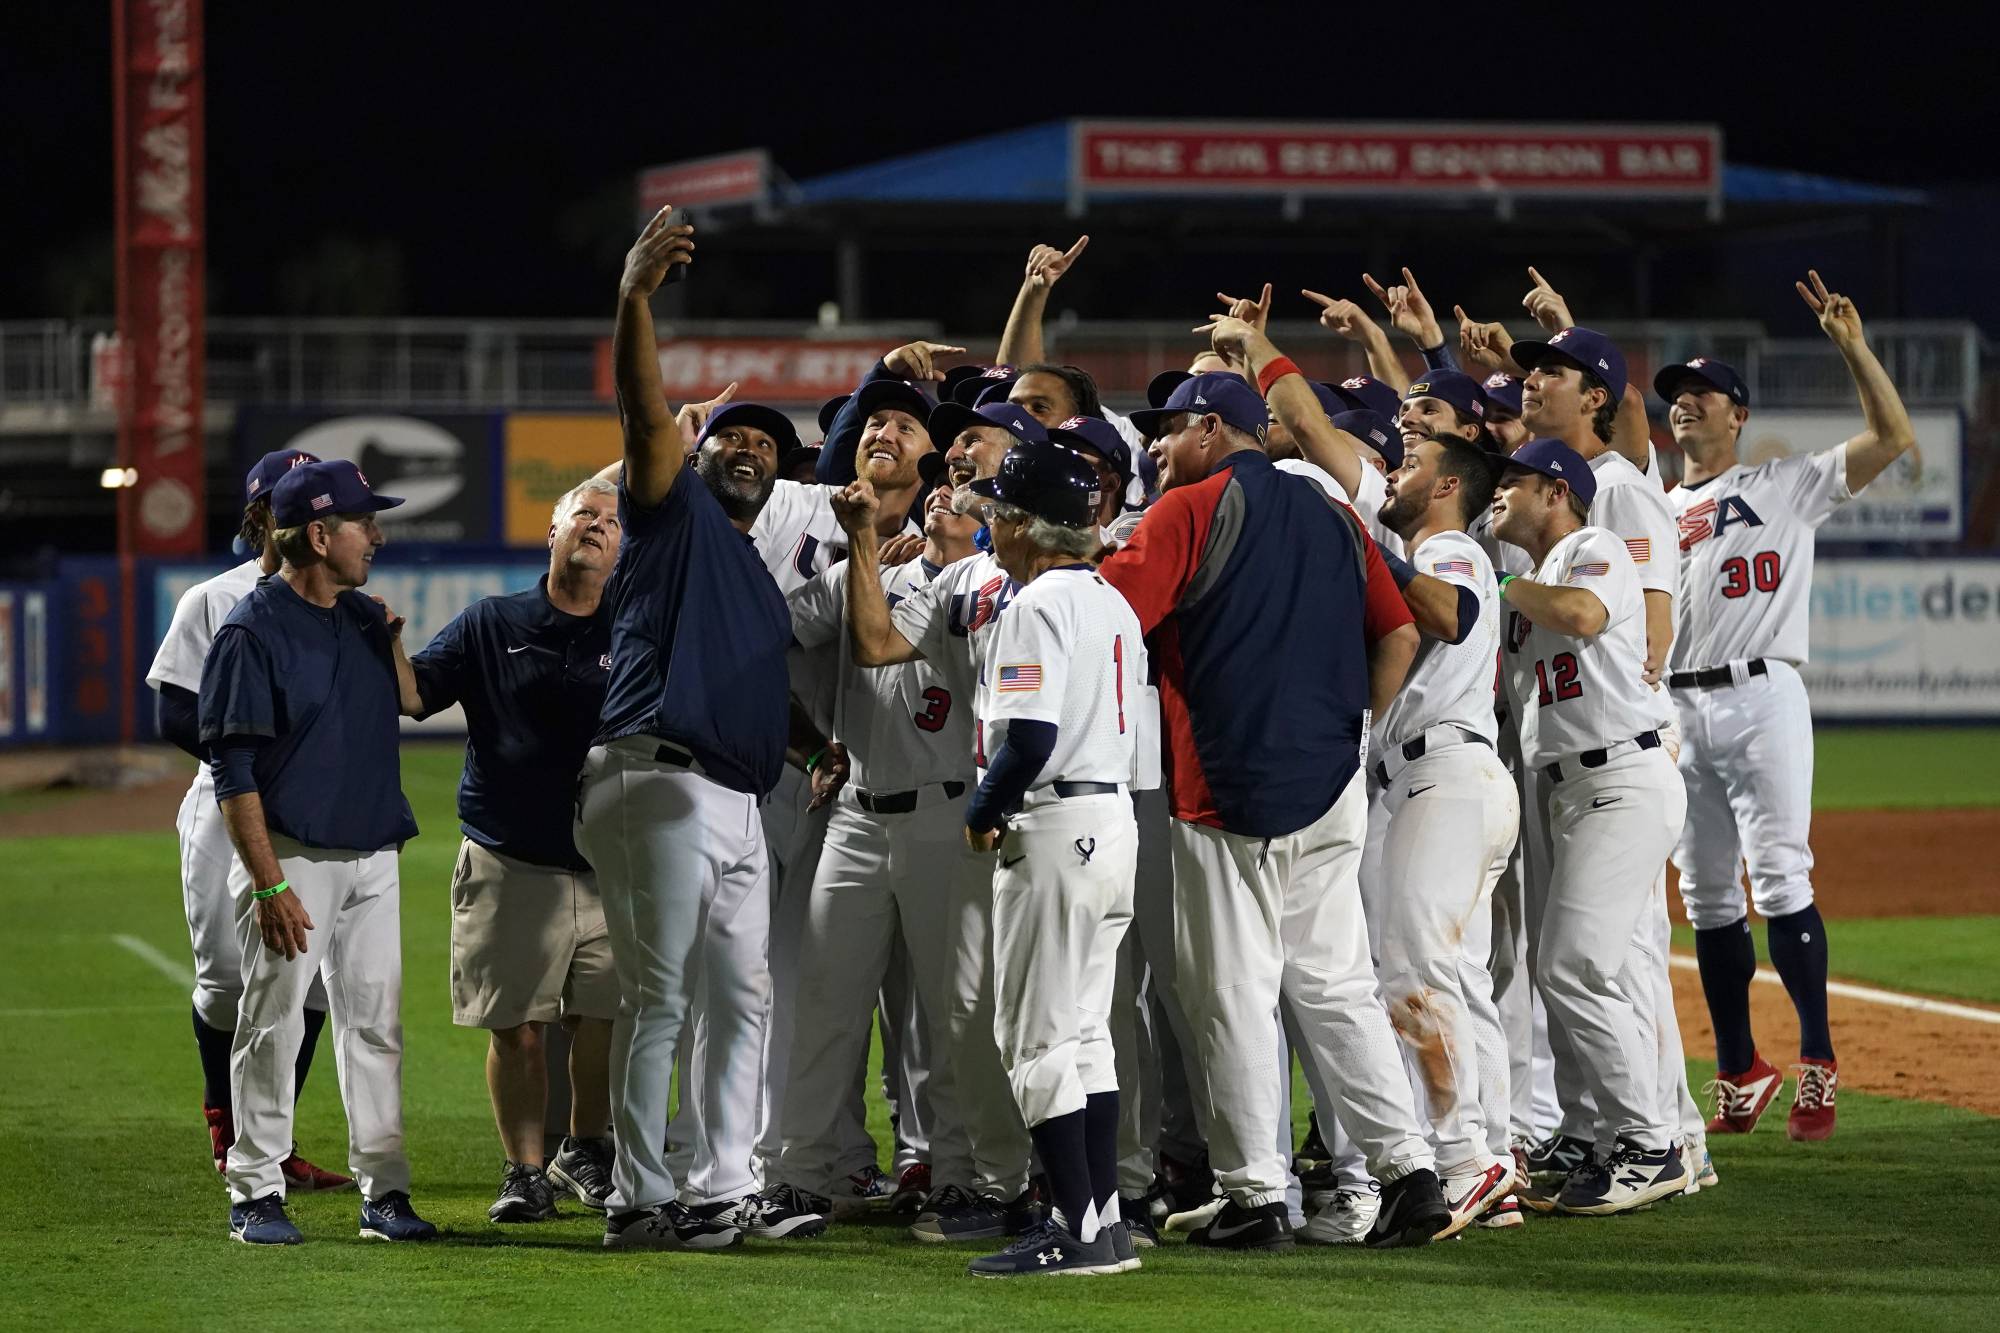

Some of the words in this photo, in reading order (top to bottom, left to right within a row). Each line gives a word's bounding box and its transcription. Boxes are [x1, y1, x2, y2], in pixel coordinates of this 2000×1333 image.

[1099, 140, 1181, 175] THE
[1196, 141, 1270, 175] JIM
[1280, 141, 1397, 176] BEAM
[1411, 142, 1605, 177] BOURBON
[1618, 143, 1699, 177] BAR
[1721, 551, 1781, 599] 30
[949, 575, 1026, 638] USA
[1113, 634, 1126, 735] 1
[1535, 652, 1583, 708] 12
[914, 686, 951, 732] 3
